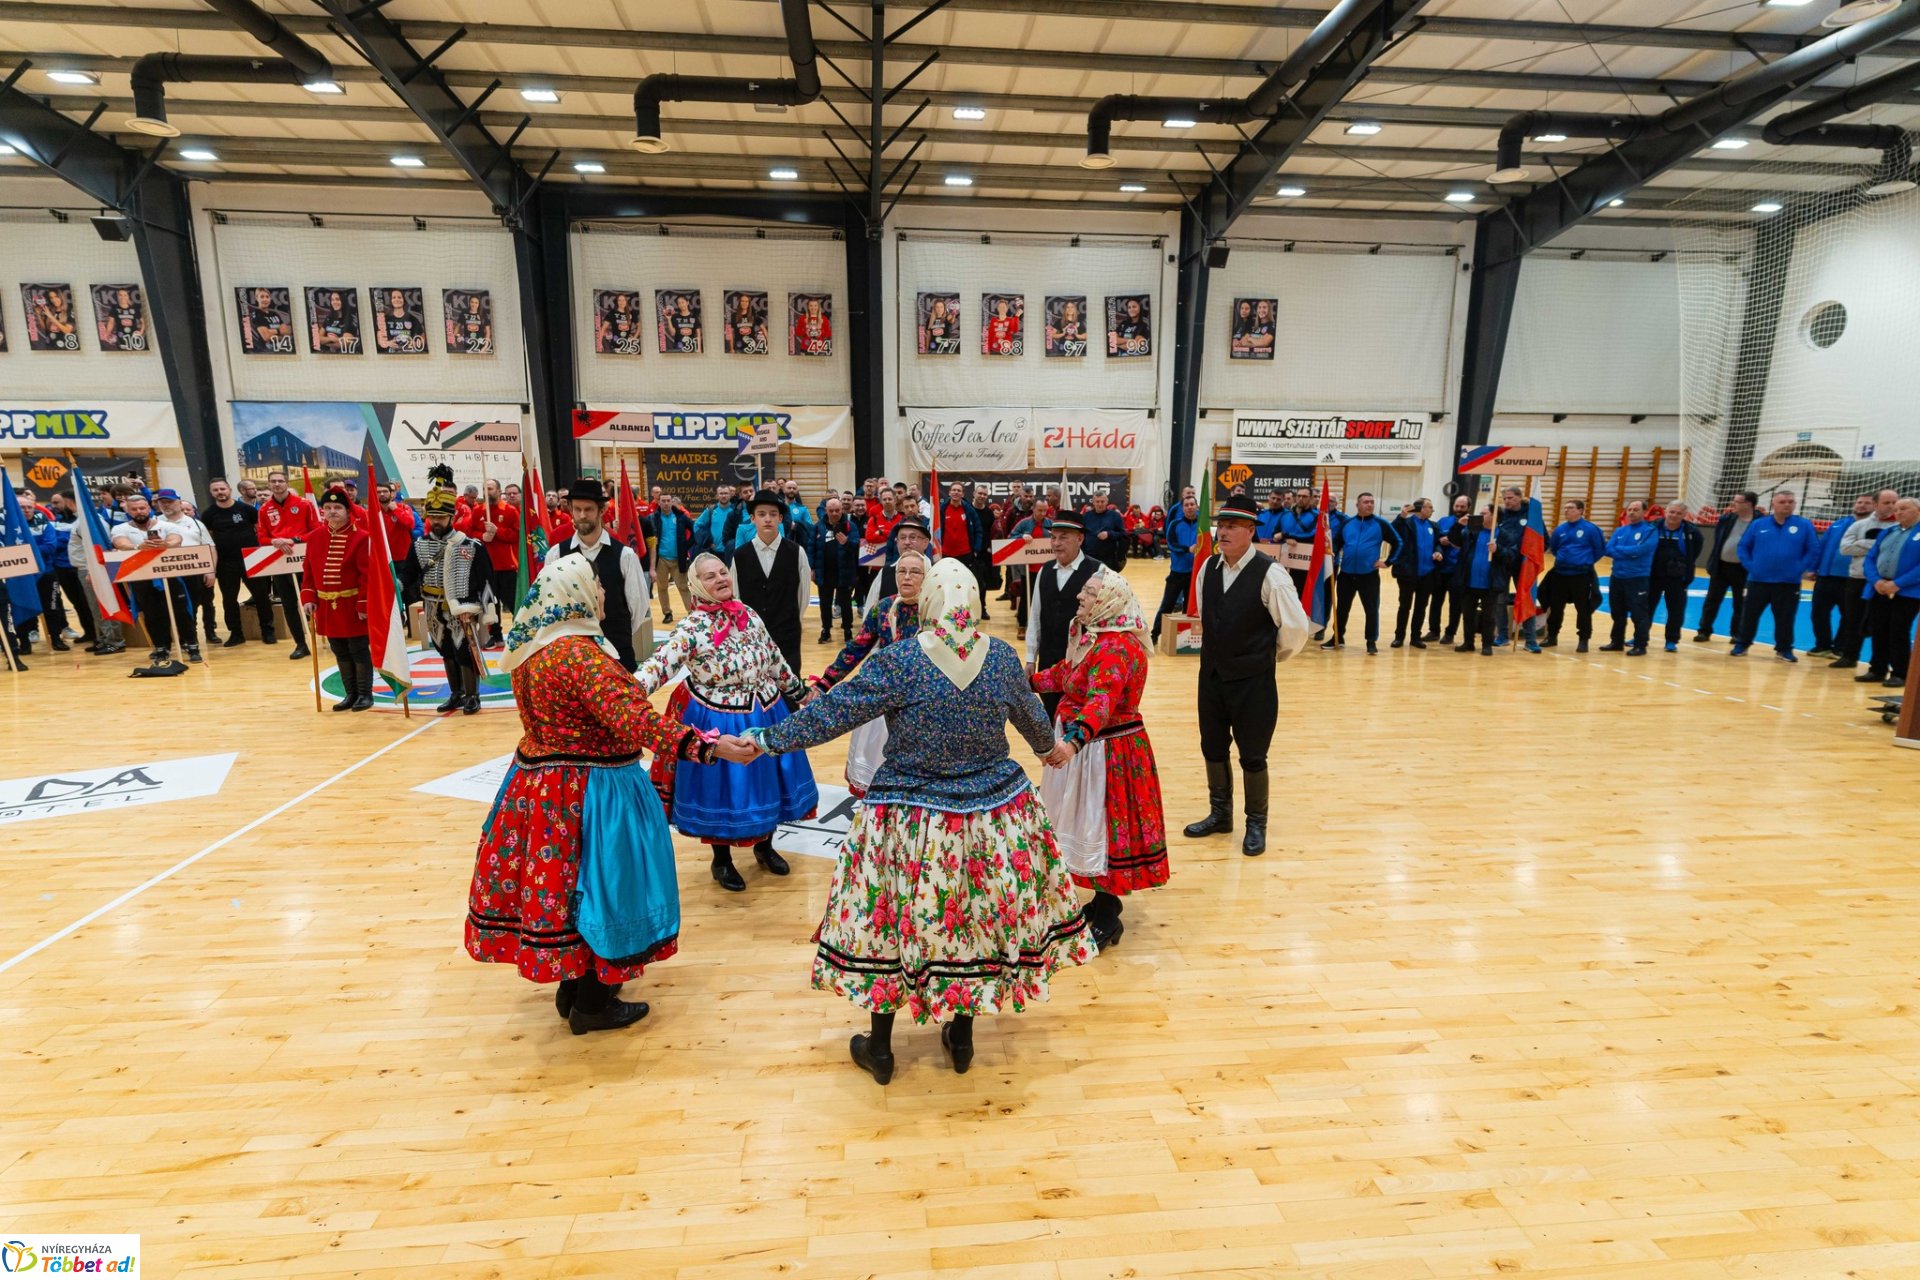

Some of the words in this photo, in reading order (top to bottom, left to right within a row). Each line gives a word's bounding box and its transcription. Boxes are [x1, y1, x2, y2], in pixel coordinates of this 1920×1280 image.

[65, 333, 79, 349] 8
[121, 334, 145, 350] 10
[270, 335, 293, 351] 14
[338, 337, 359, 353] 17
[402, 335, 425, 352] 20
[467, 337, 493, 353] 22
[615, 337, 641, 354] 25
[743, 338, 768, 353] 34
[807, 339, 832, 355] 44
[936, 338, 961, 353] 77
[1000, 340, 1023, 355] 88
[1063, 340, 1087, 356] 97
[1126, 338, 1149, 354] 98
[609, 423, 651, 432] ALBANIA
[474, 434, 518, 442] HUNGARY
[1066, 427, 1136, 449] Háda
[660, 453, 718, 465] RAMIRIS
[1494, 458, 1544, 466] SLOVENIA
[34, 466, 60, 481] EWG
[656, 467, 692, 481] AUTÓ
[696, 471, 724, 481] KFT.
[1224, 470, 1248, 483] EWG
[1254, 478, 1291, 487] EAST-WEST
[1292, 478, 1310, 487] GATE
[160, 553, 200, 563] CZECH
[152, 561, 211, 573] REPUBLIC
